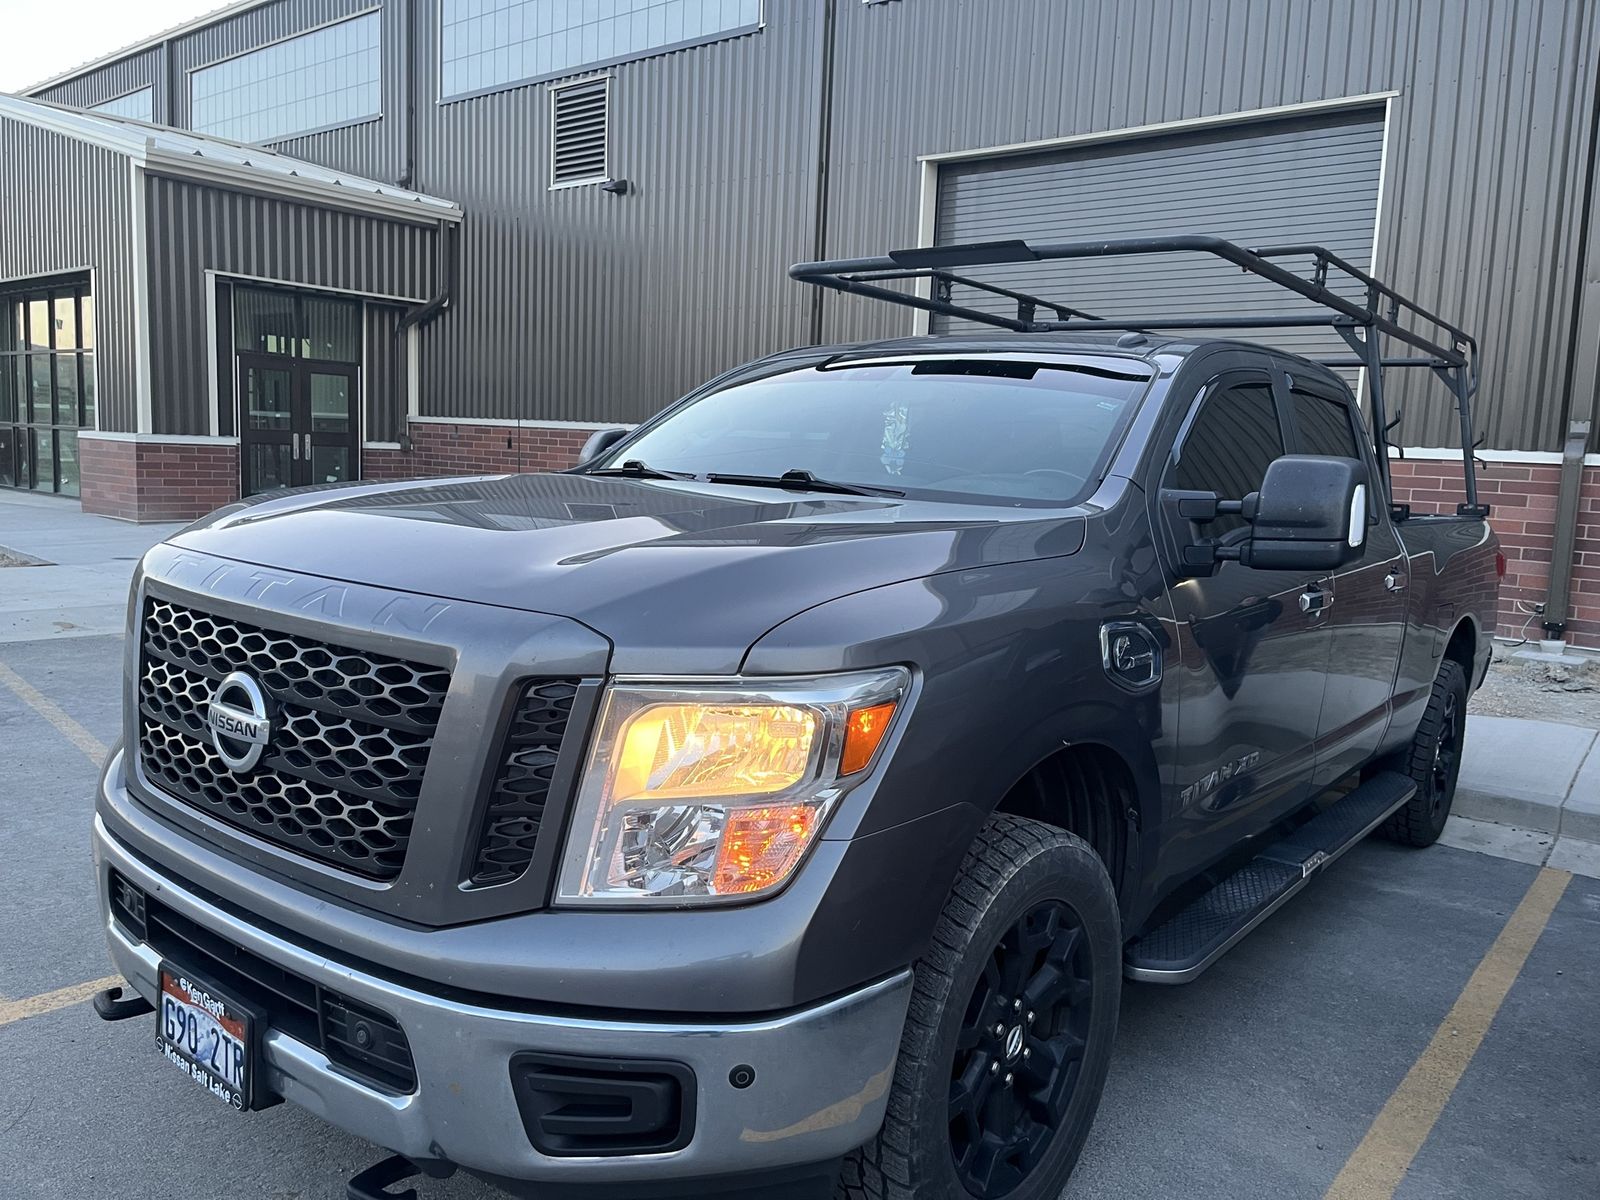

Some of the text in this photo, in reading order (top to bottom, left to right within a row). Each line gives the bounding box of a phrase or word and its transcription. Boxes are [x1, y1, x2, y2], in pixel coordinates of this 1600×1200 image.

[165, 553, 451, 633] TITAN
[208, 708, 257, 739] NISSAN
[1180, 762, 1233, 808] TITAN
[164, 1042, 231, 1103] Nissan Salt Lake
[165, 997, 244, 1089] G90 2TR
